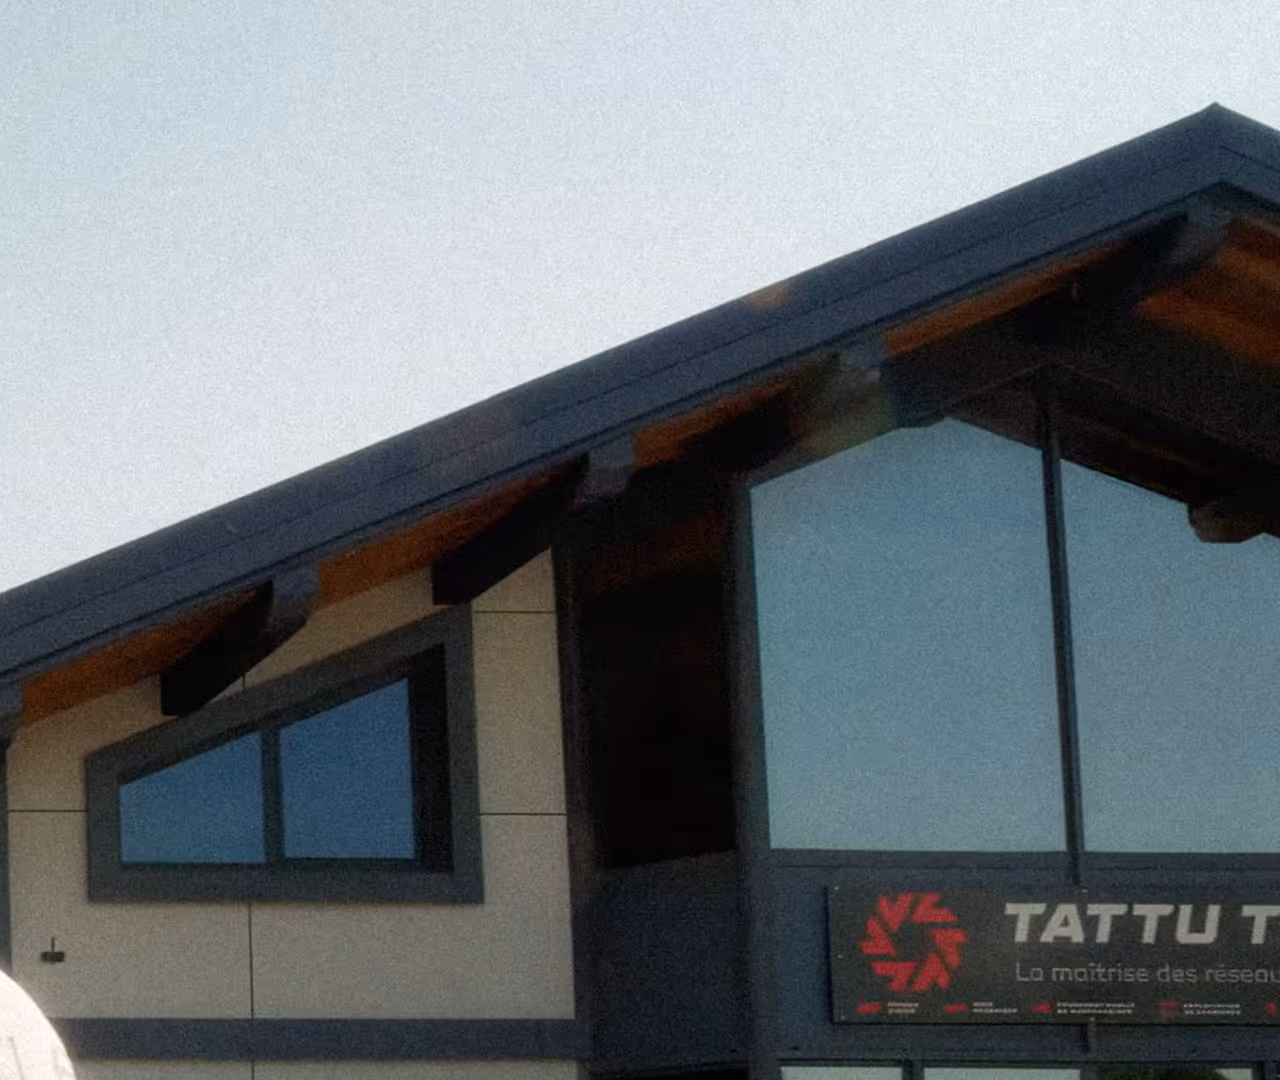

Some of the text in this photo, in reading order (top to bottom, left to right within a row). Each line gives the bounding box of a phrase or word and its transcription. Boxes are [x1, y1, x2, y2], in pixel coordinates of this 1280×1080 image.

[1004, 903, 1222, 945] TATTU
[1016, 963, 1044, 983] La
[1051, 962, 1150, 984] maîtrise
[1156, 964, 1198, 984] des
